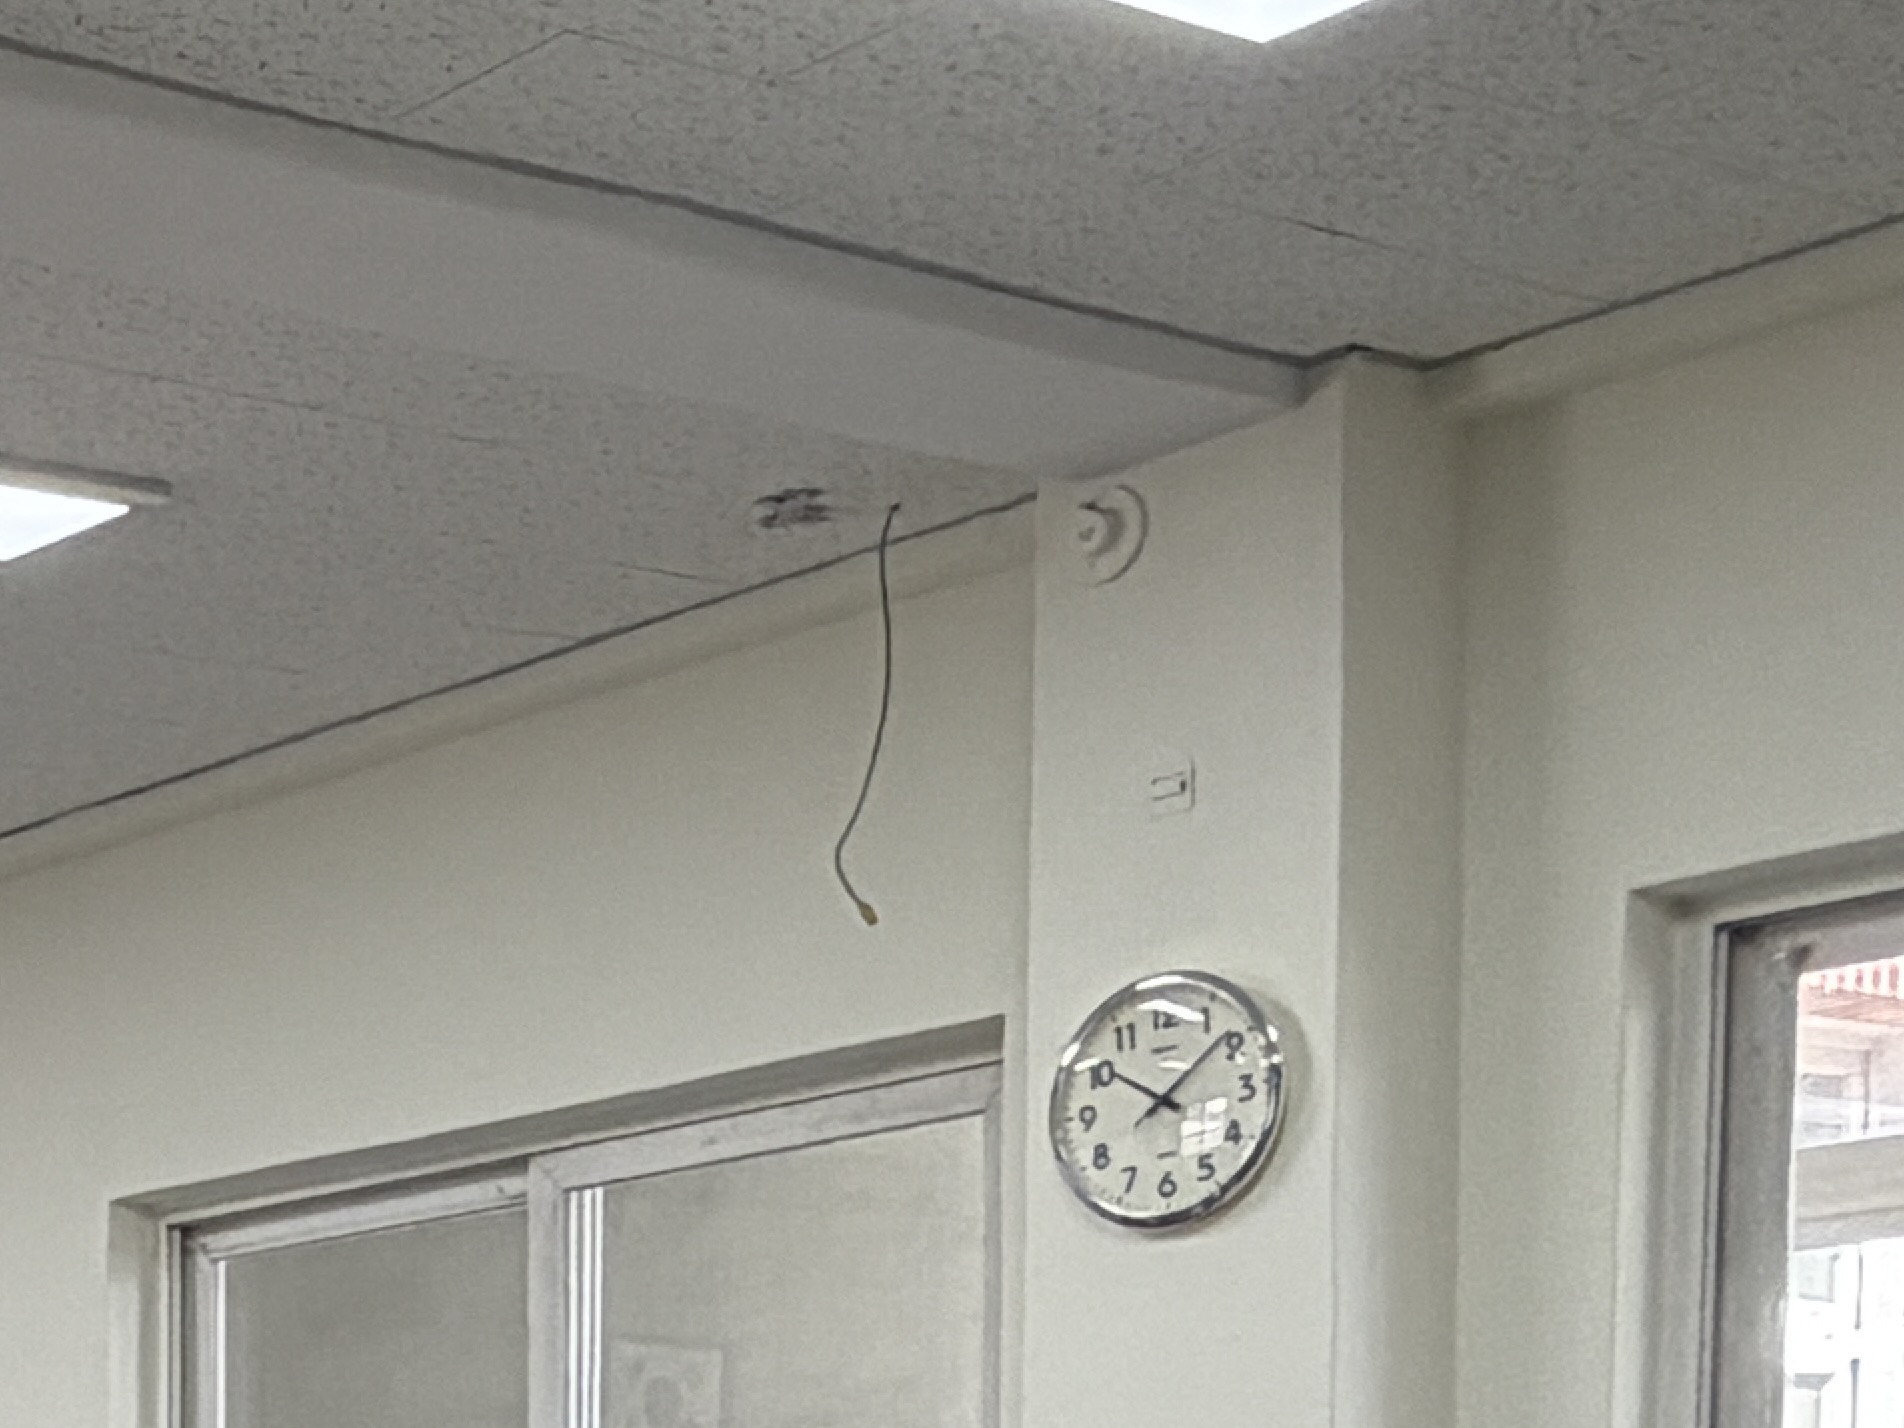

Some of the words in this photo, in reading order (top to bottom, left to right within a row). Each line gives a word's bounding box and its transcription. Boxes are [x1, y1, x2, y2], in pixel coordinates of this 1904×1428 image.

[1202, 1007, 1211, 1033] 1
[1114, 1022, 1136, 1052] 11
[1090, 1060, 1114, 1090] 10
[1237, 1074, 1256, 1102] 3
[1079, 1106, 1097, 1132] 9
[1224, 1119, 1241, 1145] 4
[1093, 1142, 1110, 1170] 8
[1197, 1153, 1216, 1182] 5
[1121, 1167, 1138, 1194] 7
[1157, 1170, 1177, 1198] 6
